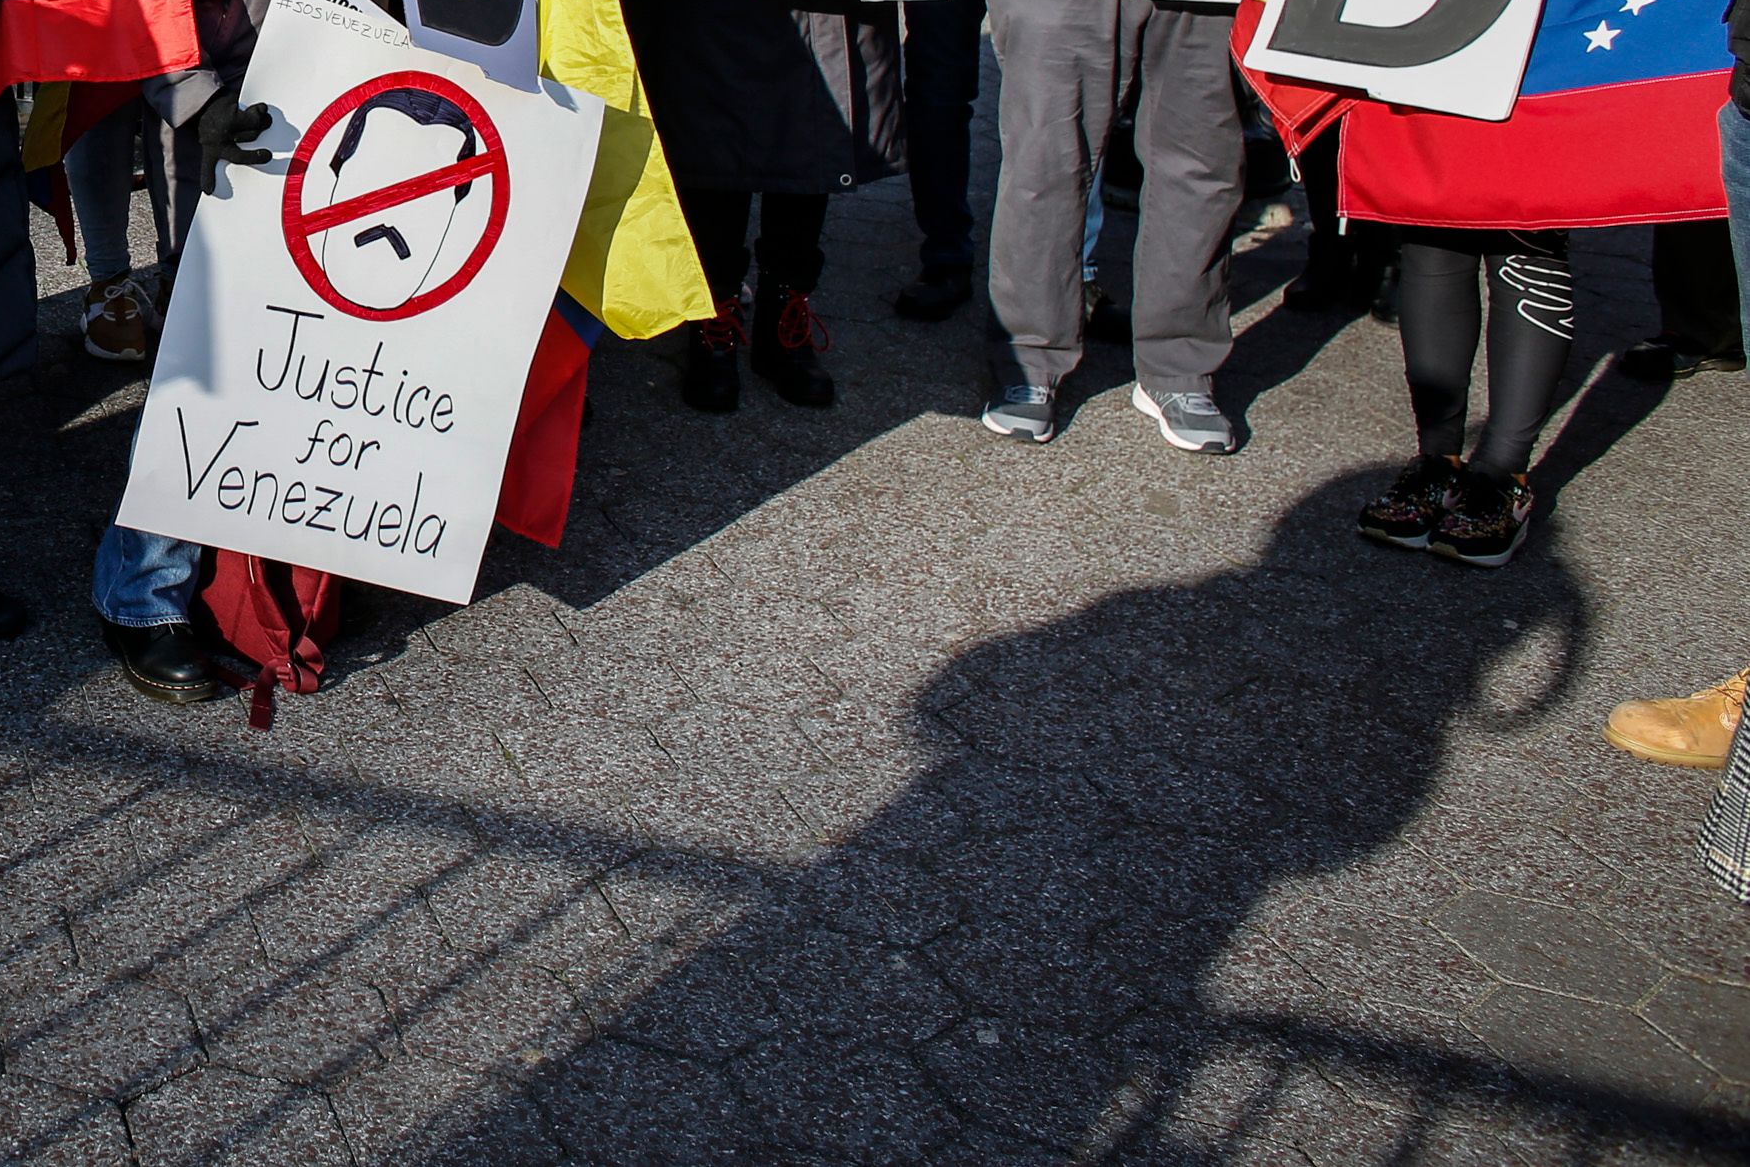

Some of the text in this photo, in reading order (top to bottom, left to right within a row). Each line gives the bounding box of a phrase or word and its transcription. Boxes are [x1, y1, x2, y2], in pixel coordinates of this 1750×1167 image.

[257, 304, 455, 434] Justice
[177, 407, 447, 558] Venezuela
[295, 419, 381, 470] for
